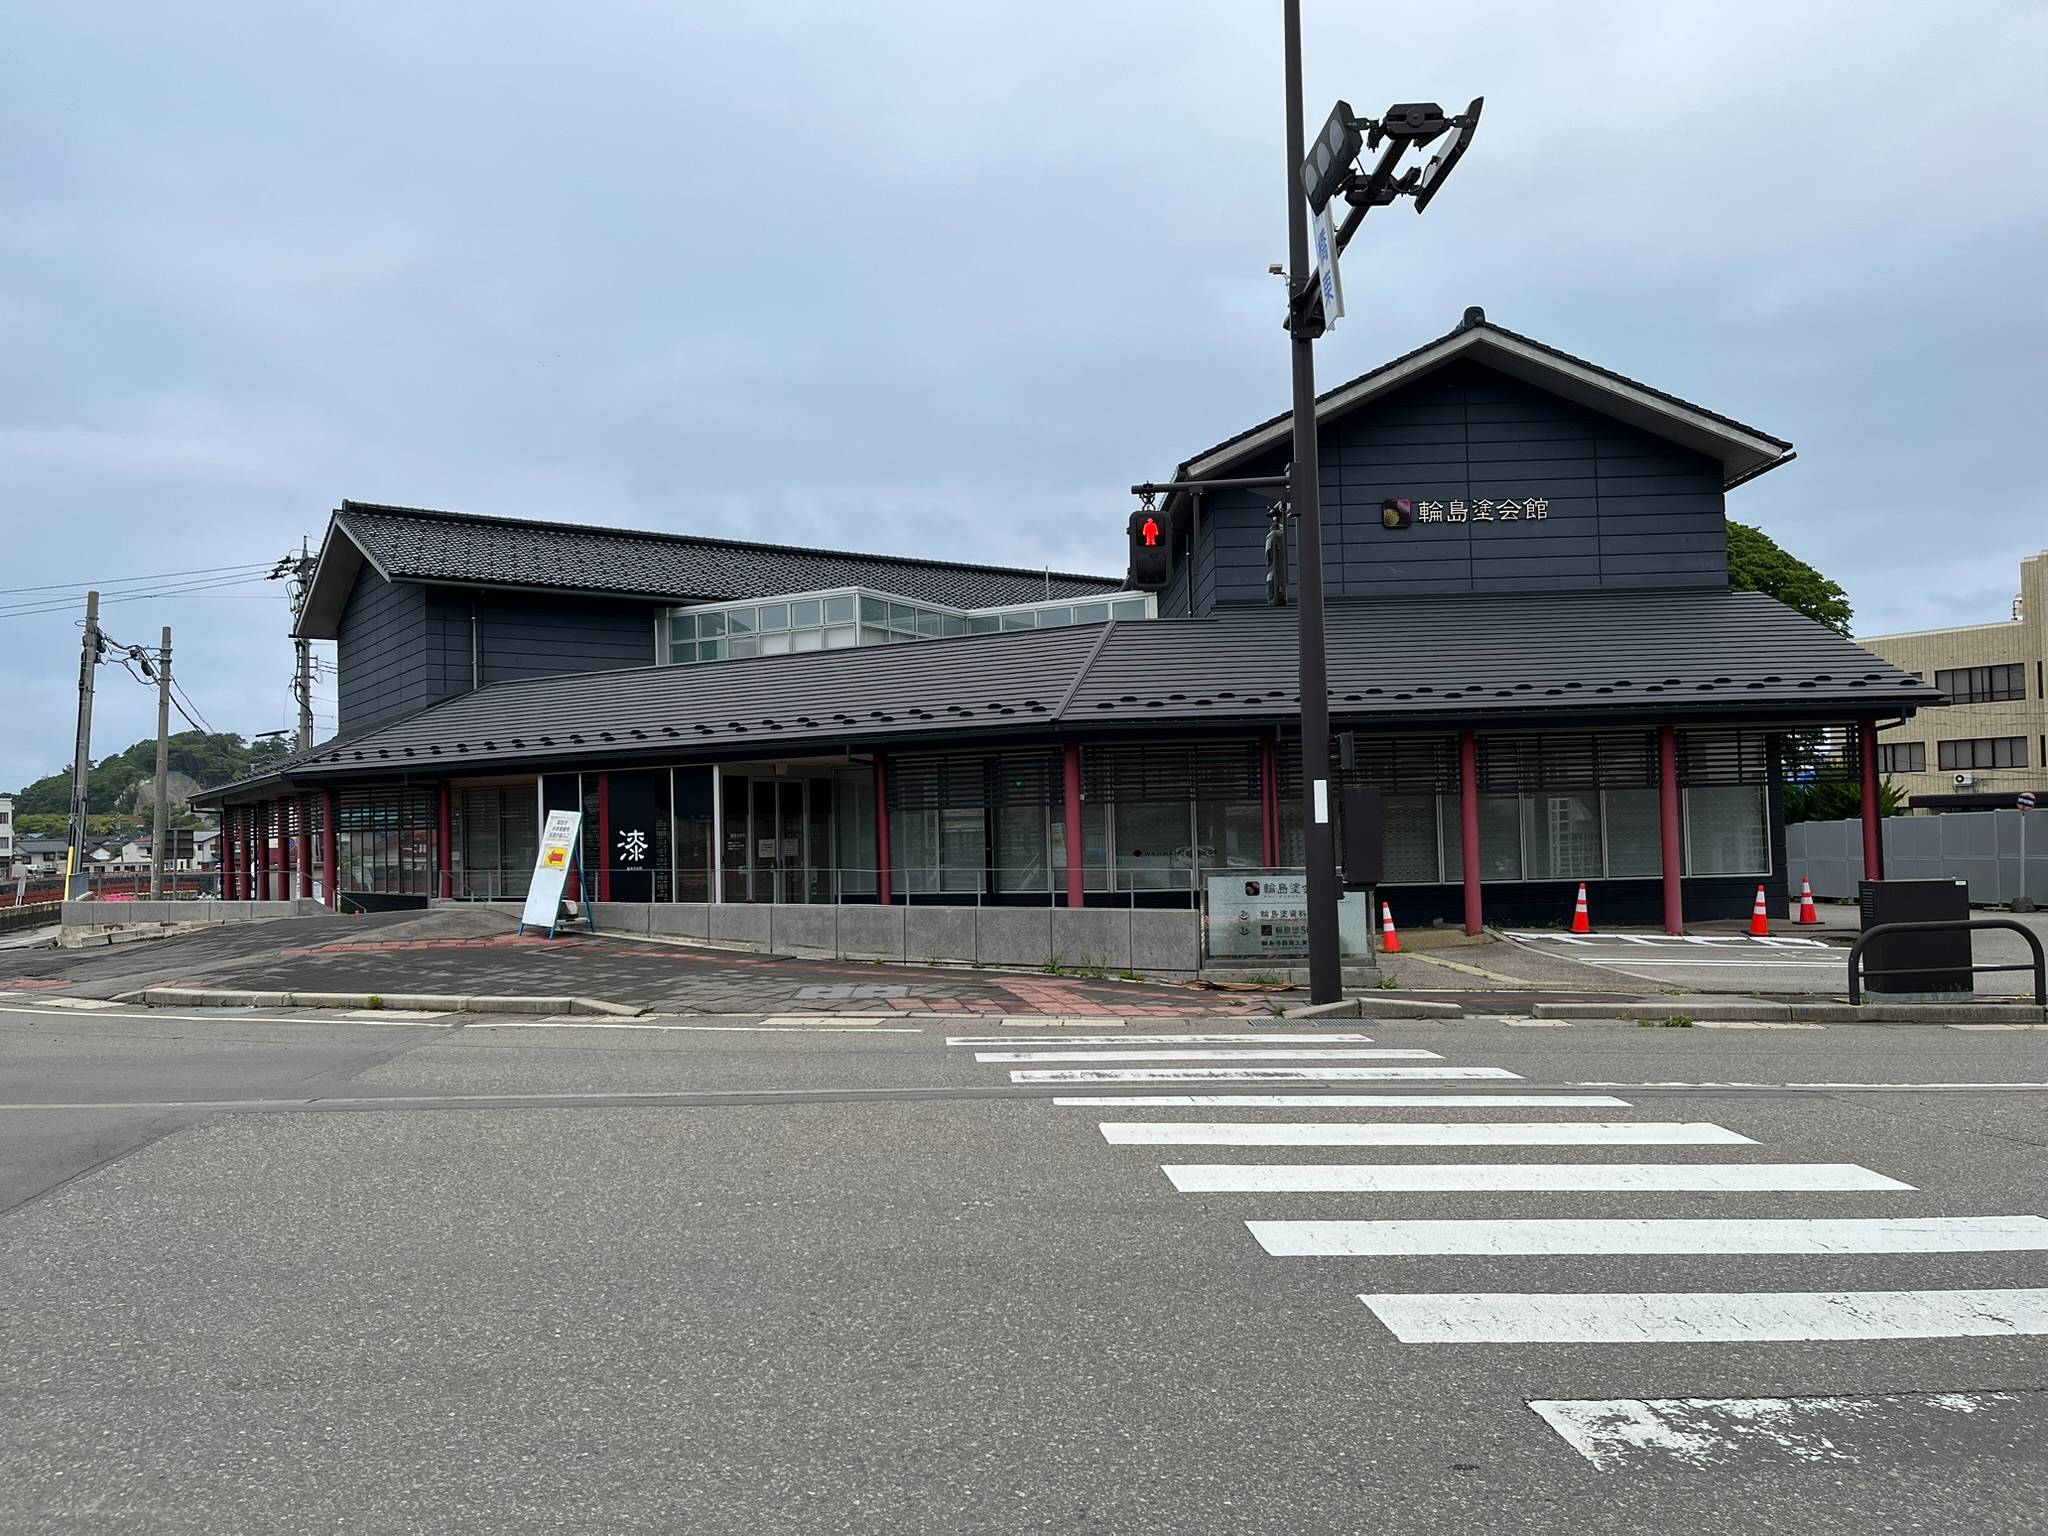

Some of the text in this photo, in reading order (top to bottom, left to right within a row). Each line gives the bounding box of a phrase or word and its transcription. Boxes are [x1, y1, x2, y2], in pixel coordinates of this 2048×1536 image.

[1418, 497, 1549, 523] 輪島塗会館
[617, 829, 648, 861] 漆
